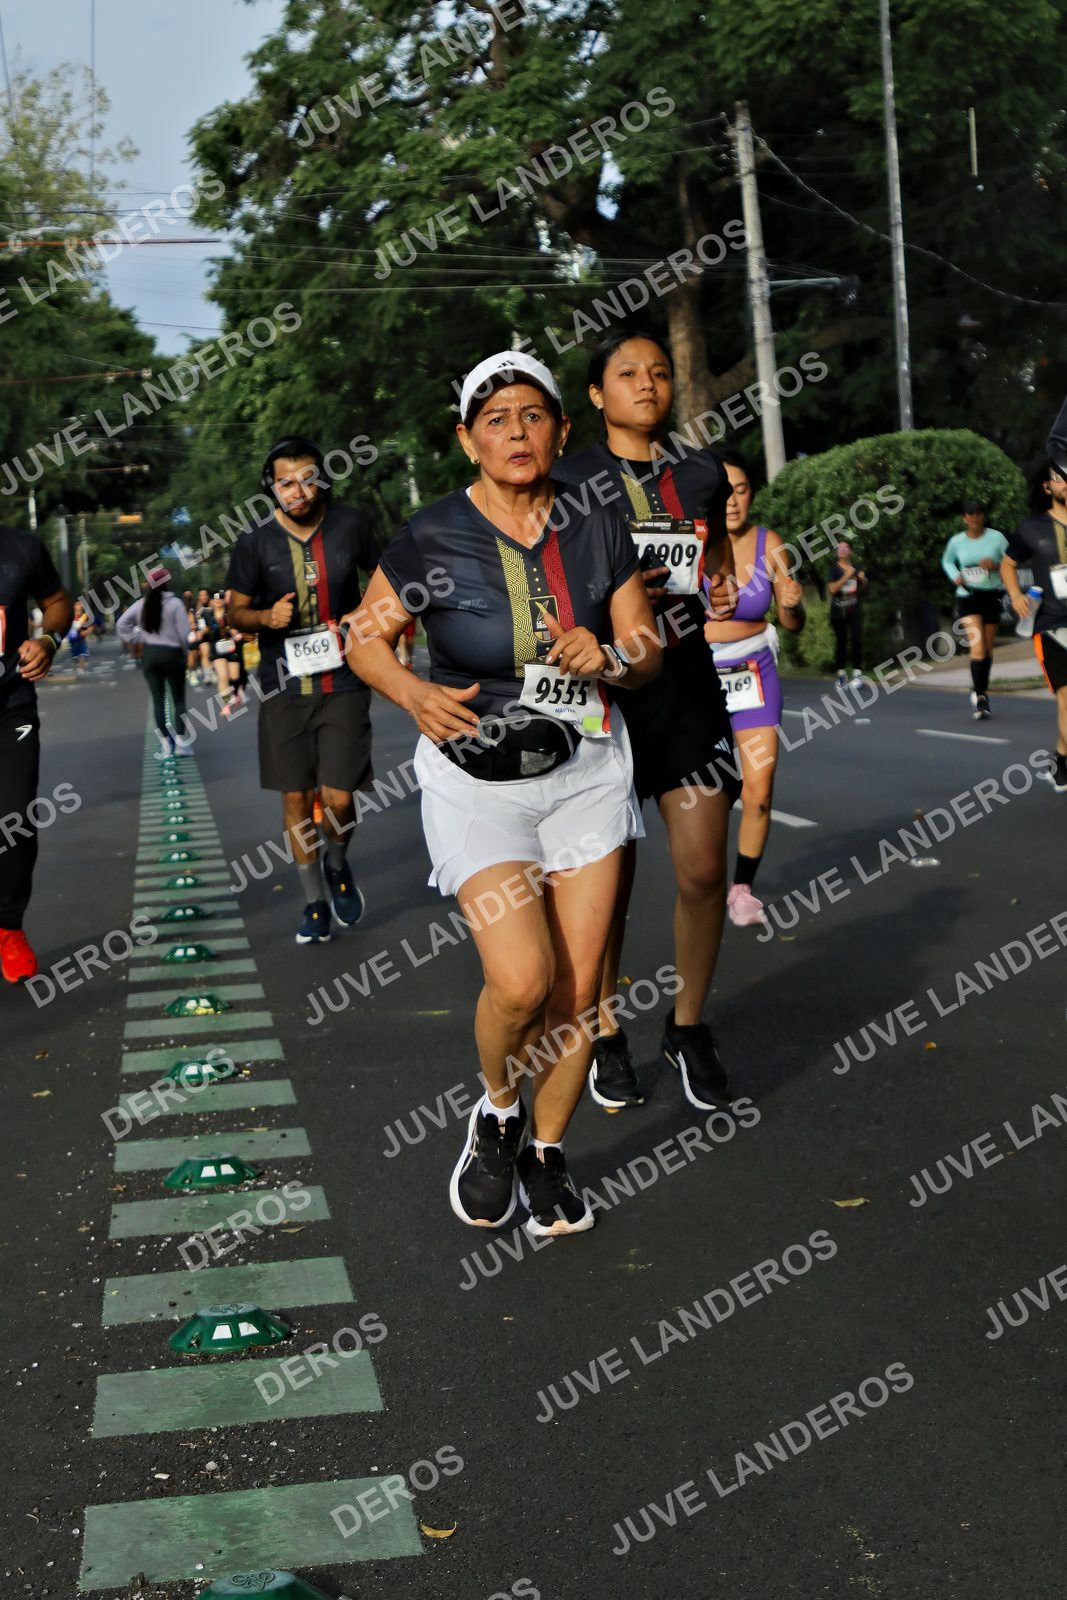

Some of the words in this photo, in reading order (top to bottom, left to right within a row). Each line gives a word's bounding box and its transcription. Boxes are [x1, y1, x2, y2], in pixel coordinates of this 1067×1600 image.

[293, 638, 330, 658] 8669
[534, 676, 591, 706] 9555
[724, 675, 752, 693] 169
